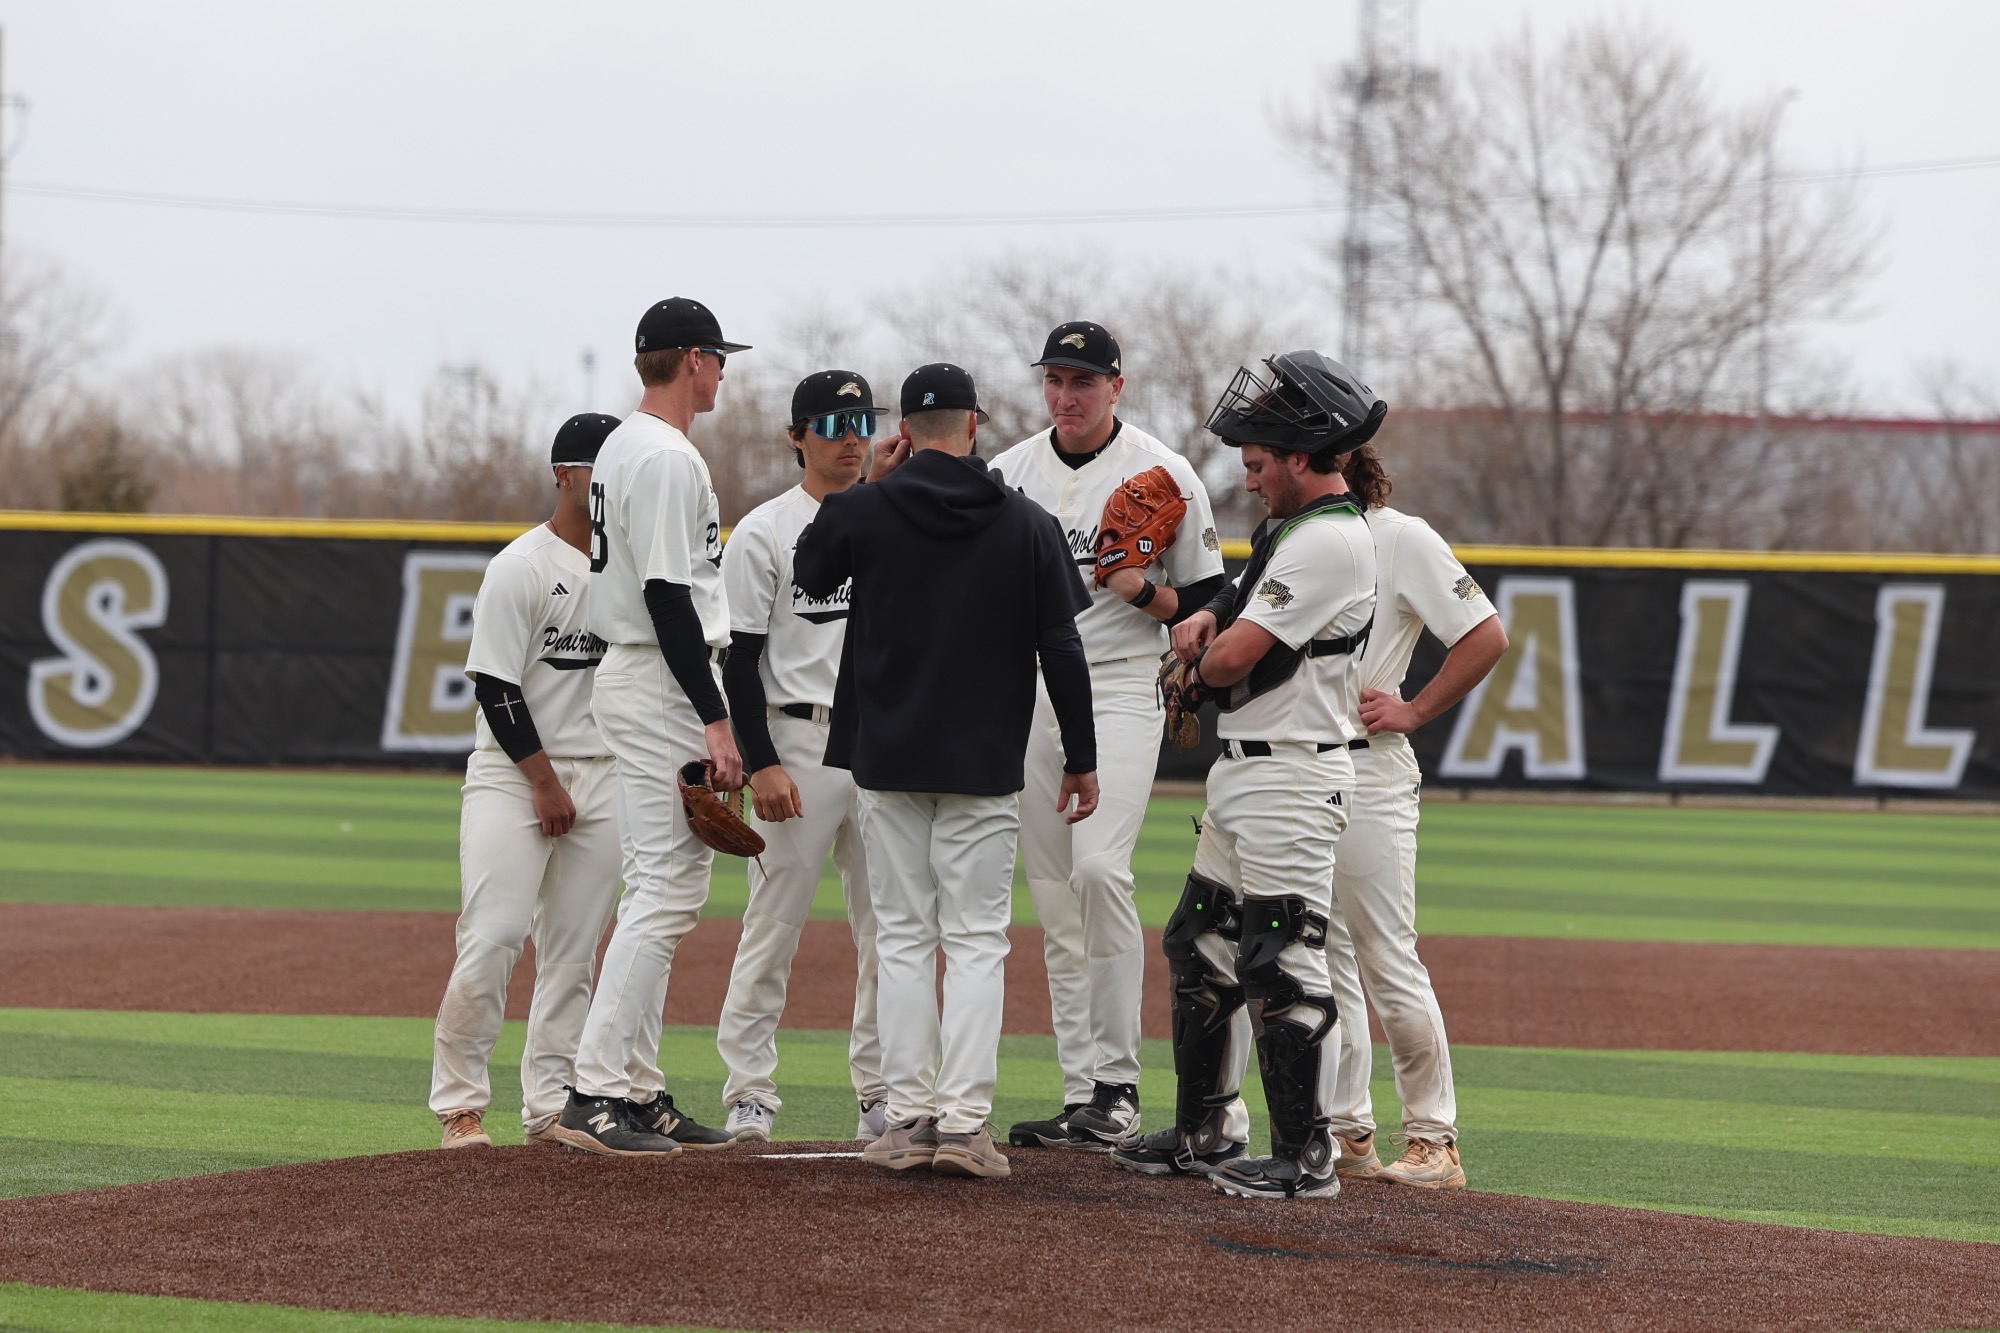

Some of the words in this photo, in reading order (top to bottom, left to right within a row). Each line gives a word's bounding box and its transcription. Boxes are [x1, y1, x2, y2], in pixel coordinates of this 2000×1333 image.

[1067, 524, 1098, 554] Wol
[1099, 550, 1127, 567] Wilson
[540, 626, 590, 654] Prairi
